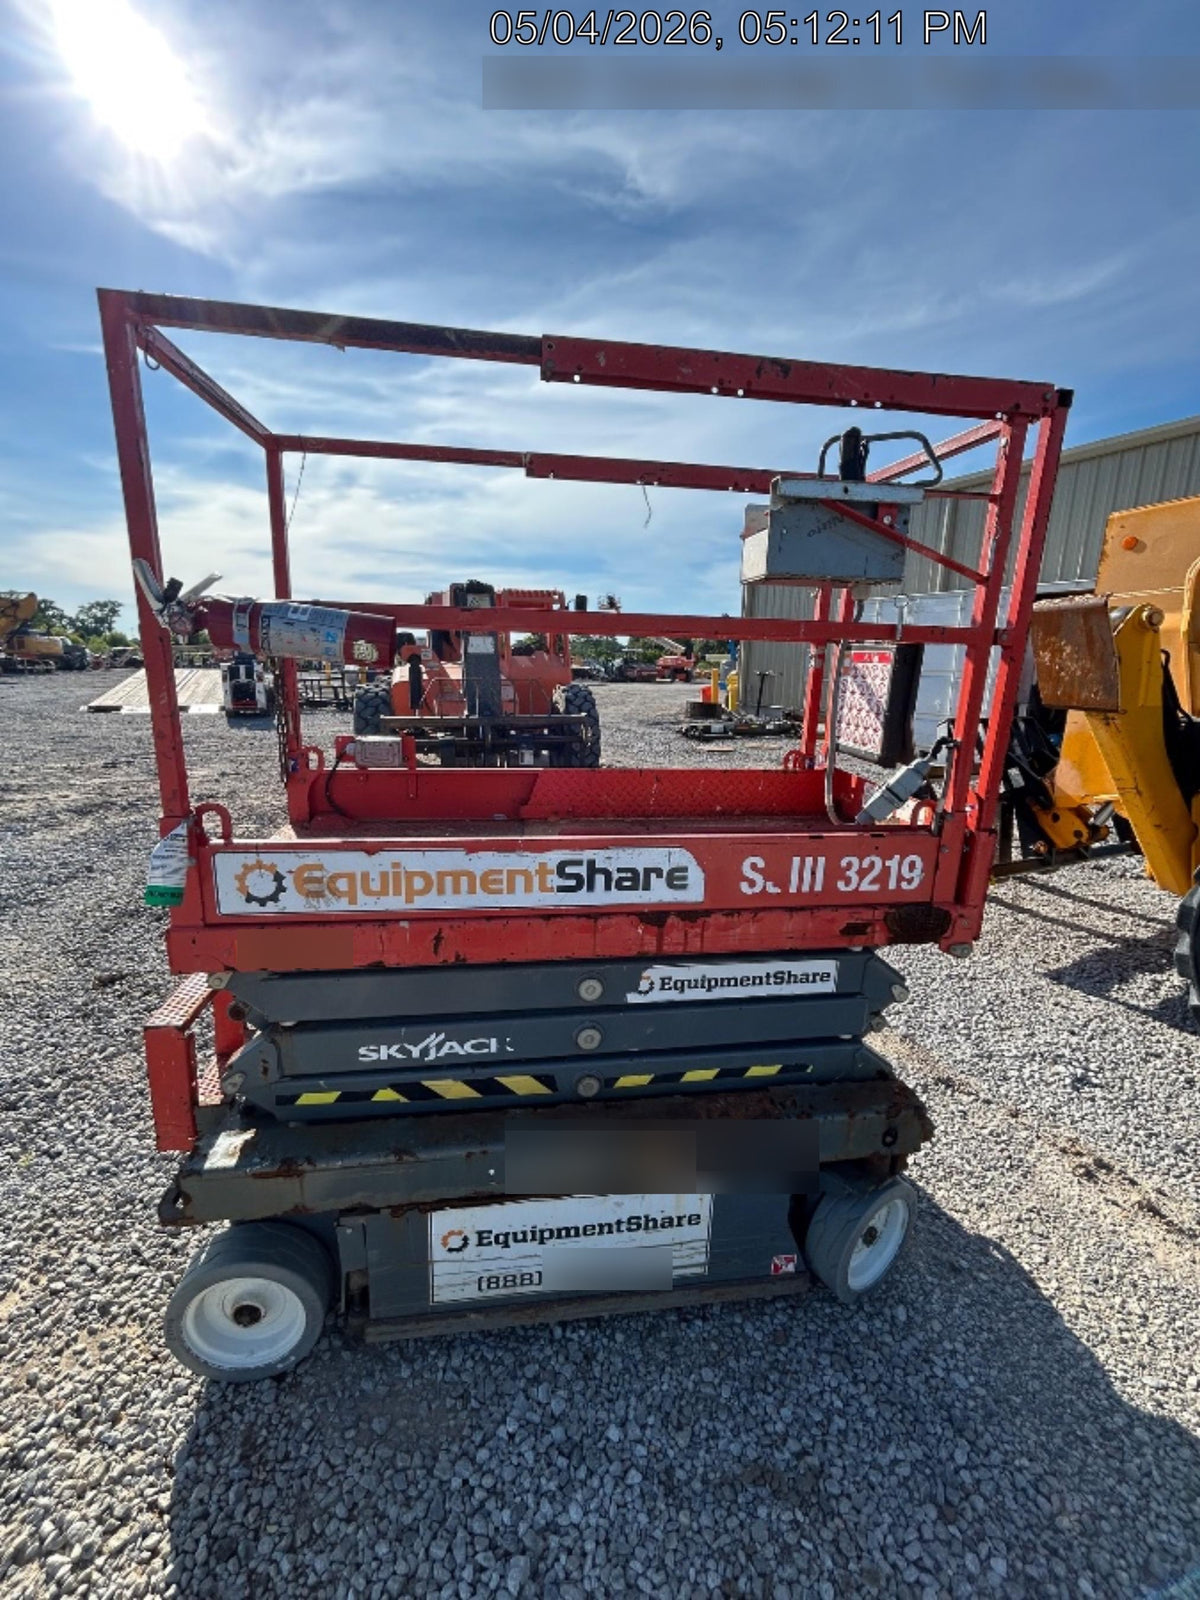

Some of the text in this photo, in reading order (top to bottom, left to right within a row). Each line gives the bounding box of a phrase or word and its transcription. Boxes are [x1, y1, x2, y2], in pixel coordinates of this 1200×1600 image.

[292, 859, 690, 905] EquipmentShare
[836, 854, 925, 892] 3219
[658, 969, 832, 994] EquipmentShare
[475, 1211, 702, 1249] EquipmentShare
